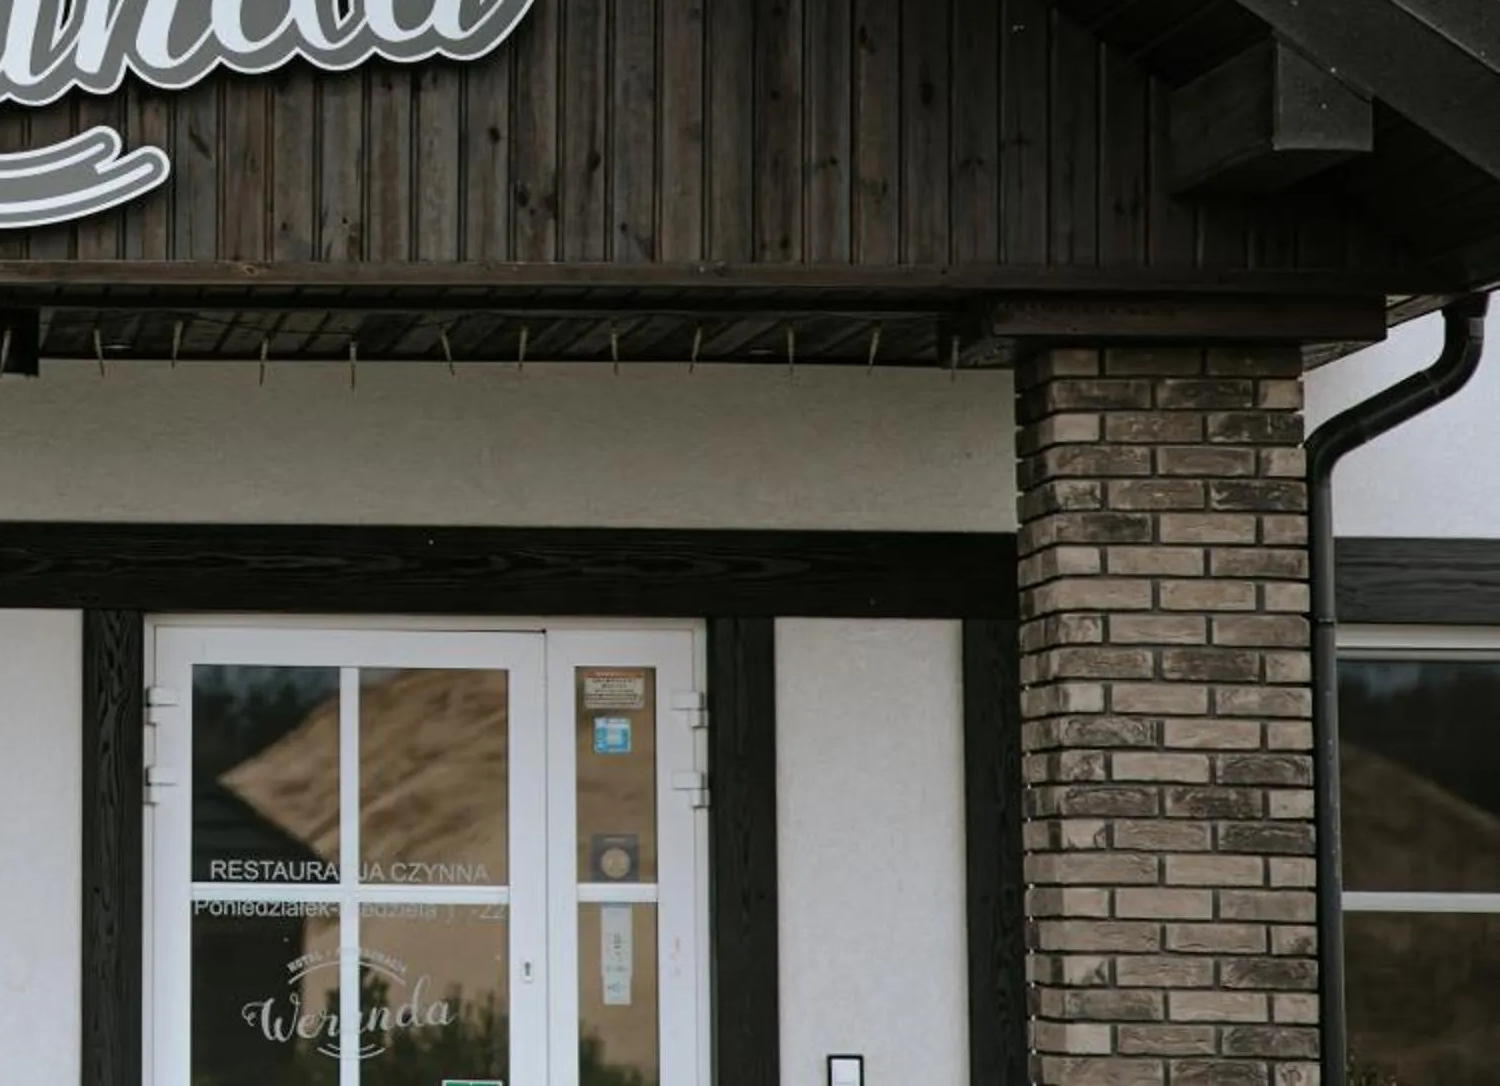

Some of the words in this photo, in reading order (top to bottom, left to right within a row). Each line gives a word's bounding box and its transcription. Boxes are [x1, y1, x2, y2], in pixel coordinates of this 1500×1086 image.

[211, 859, 385, 881] RESTAURAJA
[390, 861, 492, 882] CZYNNA
[241, 975, 454, 1042] Wernda
